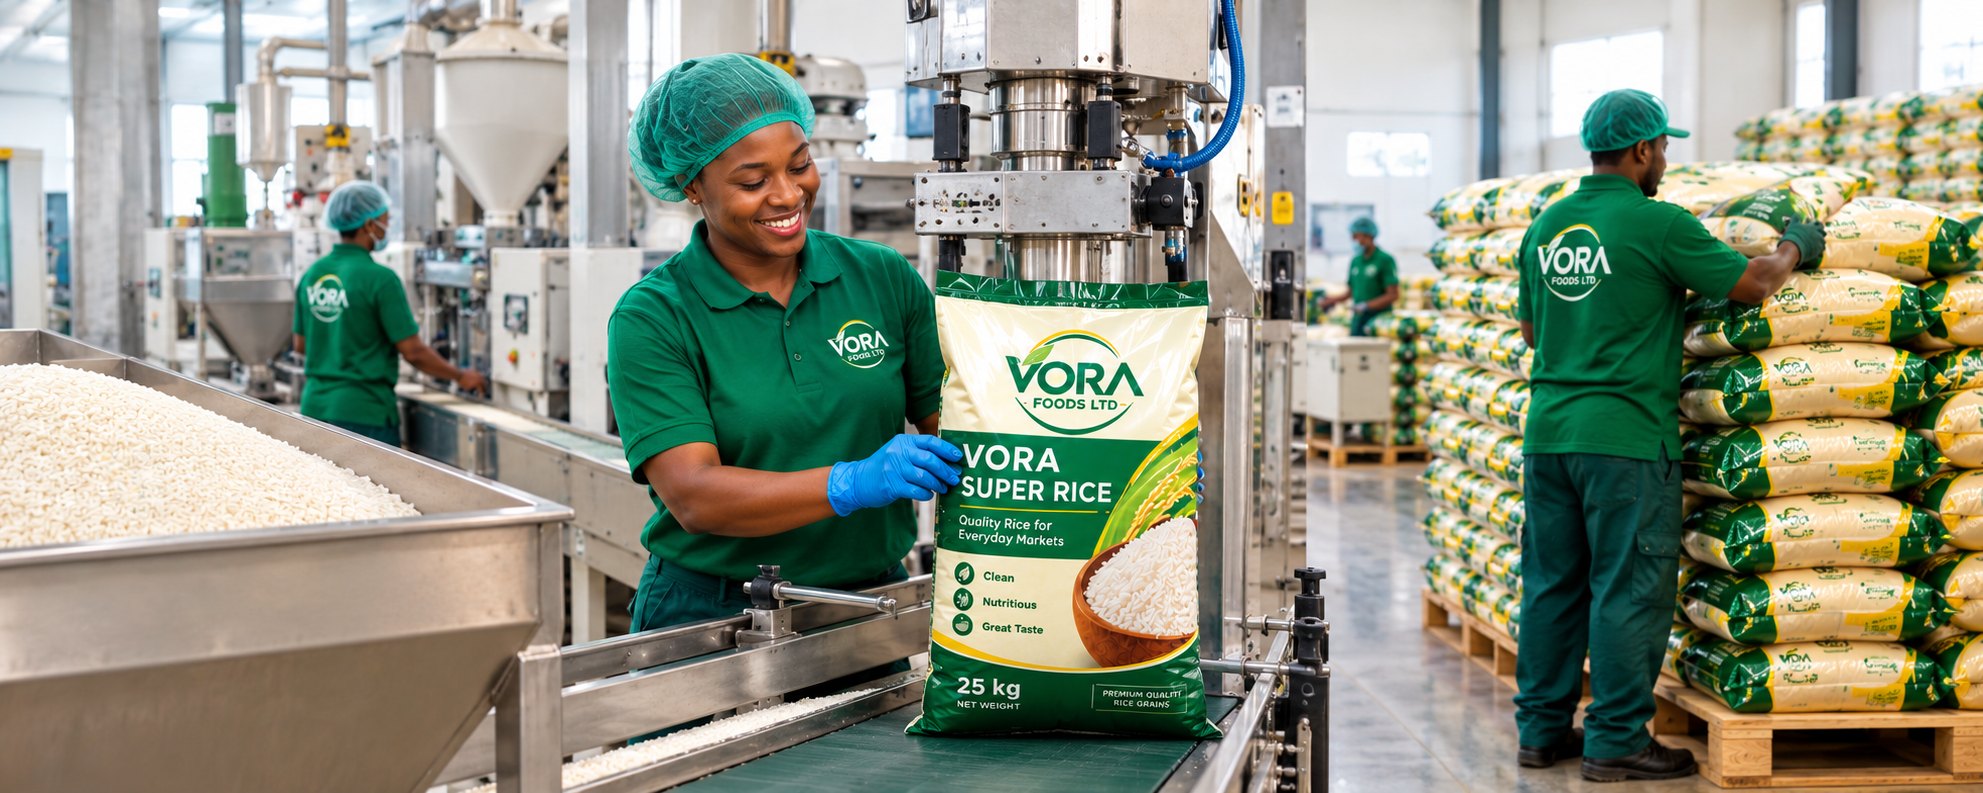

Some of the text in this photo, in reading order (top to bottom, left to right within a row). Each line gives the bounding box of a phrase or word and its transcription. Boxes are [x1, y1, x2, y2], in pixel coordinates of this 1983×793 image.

[1537, 246, 1612, 275] VORA
[1551, 276, 1597, 285] FOODS LTD
[306, 286, 350, 308] VORA
[827, 330, 890, 357] VORA
[1005, 355, 1145, 397] VORA
[1033, 398, 1118, 411] FOODS LTD
[962, 443, 1061, 473] VORA
[961, 475, 1112, 503] SUPER RICE
[959, 514, 1053, 531] Quality Rice for
[958, 529, 1064, 547] Everyday Markets
[983, 571, 1015, 583] Clean
[982, 597, 1037, 610] Nutritious
[982, 622, 1044, 635] Great Taste
[957, 677, 1021, 700] 25 kg
[1102, 689, 1143, 698] PREMIUM
[957, 700, 1021, 710] NET WEIGHT
[1113, 699, 1170, 709] RICE GRAINS
